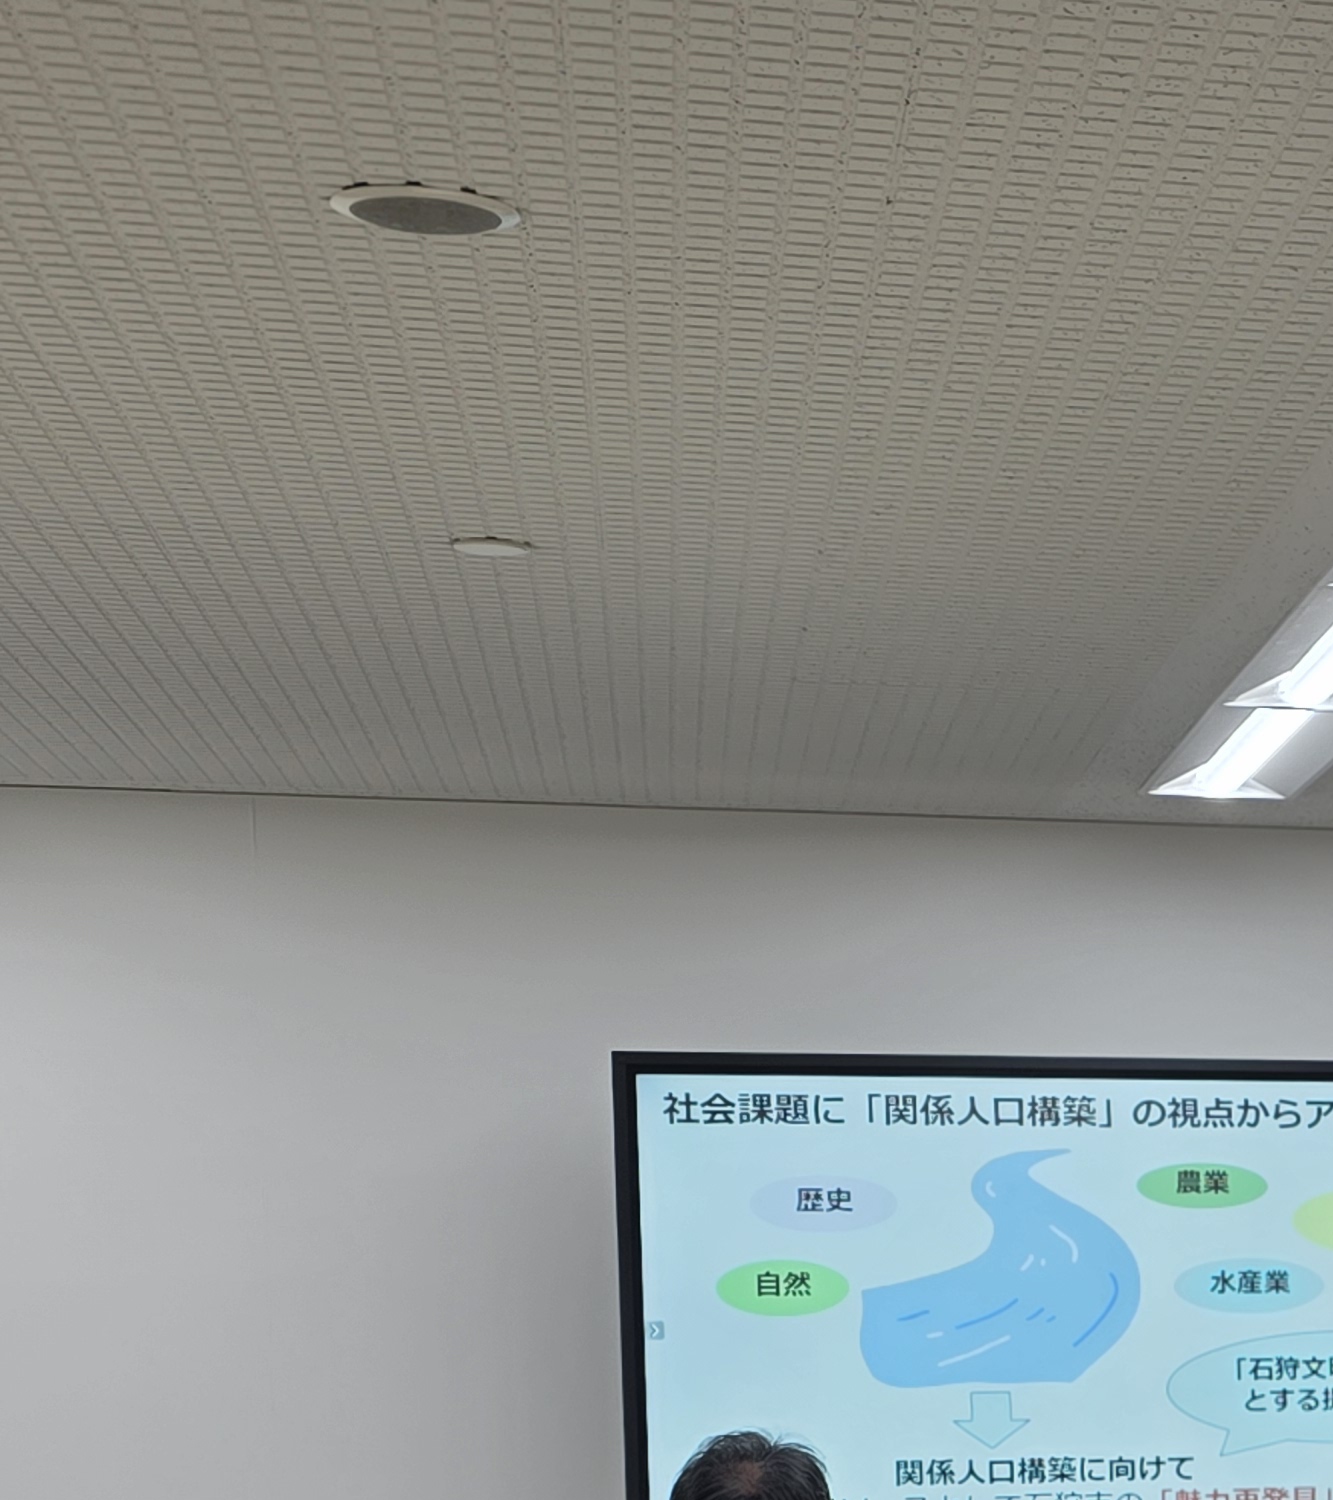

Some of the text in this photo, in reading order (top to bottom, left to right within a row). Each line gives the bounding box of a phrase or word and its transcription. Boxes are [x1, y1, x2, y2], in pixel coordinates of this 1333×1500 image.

[1176, 1170, 1230, 1195] 農業
[796, 1187, 853, 1212] 歴史
[757, 1271, 812, 1297] 自然
[1210, 1270, 1291, 1295] 水産業
[895, 1456, 1195, 1487] 関係人口構築に向けて
